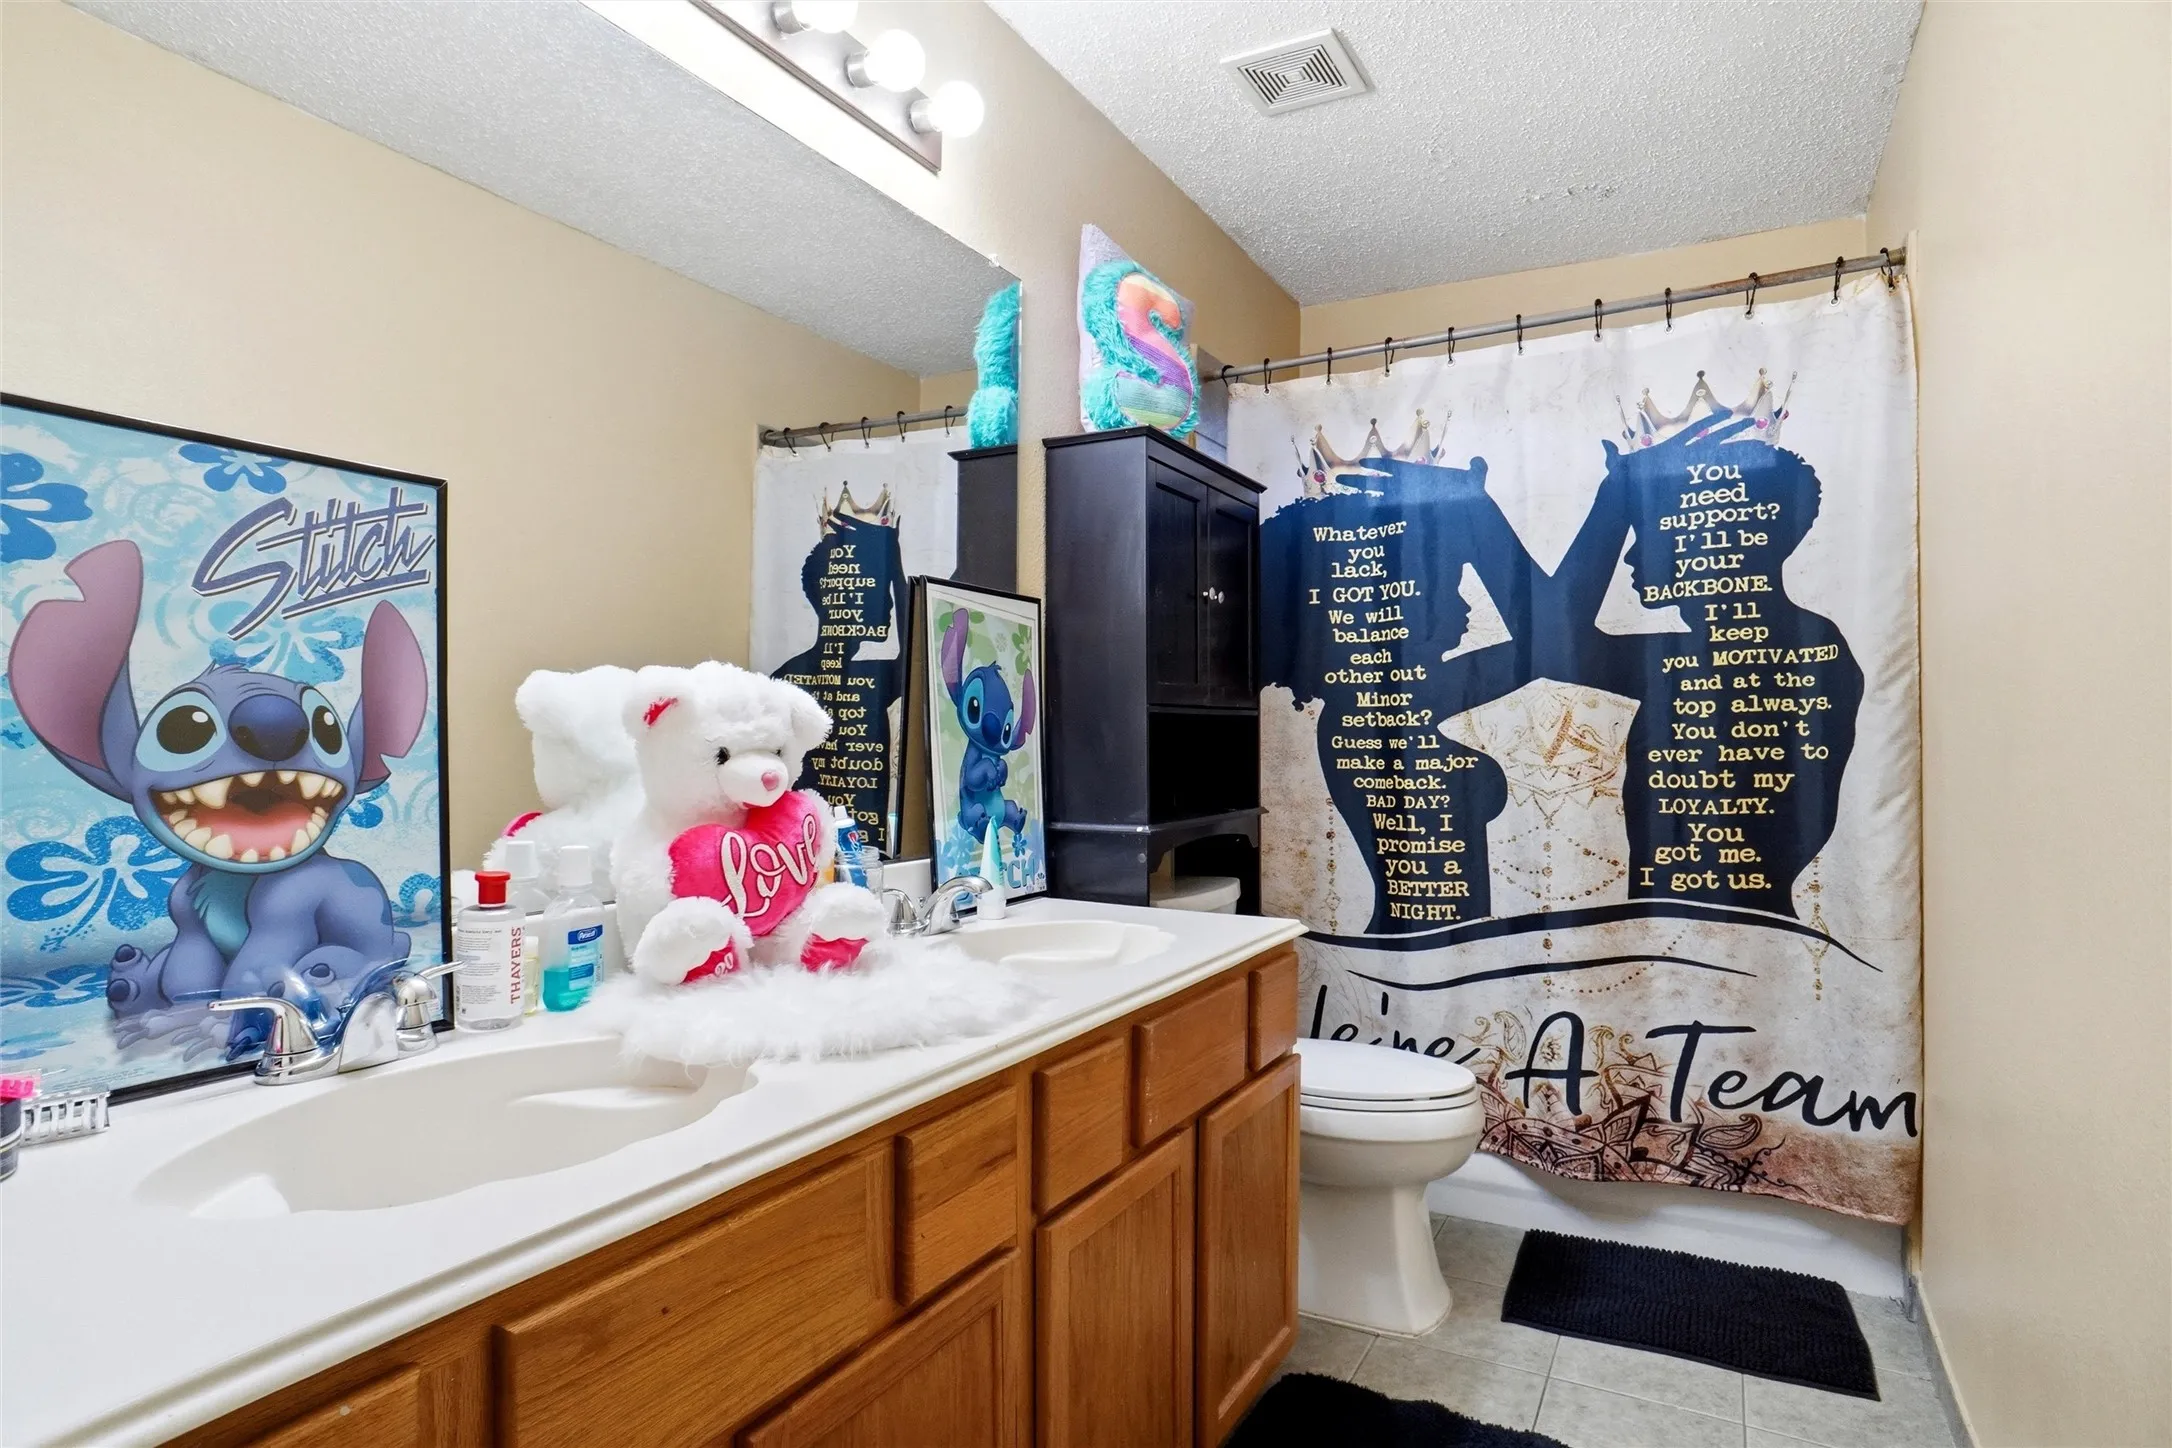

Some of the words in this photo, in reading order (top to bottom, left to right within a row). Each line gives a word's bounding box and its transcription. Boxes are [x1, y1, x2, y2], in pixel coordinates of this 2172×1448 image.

[1685, 463, 1742, 483] You
[1679, 482, 1750, 509] need
[1659, 501, 1781, 531] support?
[1312, 520, 1408, 542] Whatever
[1674, 530, 1732, 553] I'll
[1738, 529, 1768, 546] be
[191, 487, 435, 641] Stitch
[1347, 545, 1386, 565] you
[1331, 560, 1388, 579] lack,
[1675, 553, 1745, 578] your
[1308, 588, 1321, 605] I
[1332, 586, 1375, 603] GOT
[1378, 579, 1421, 601] YOU.
[1643, 574, 1773, 602] BACKBONE.
[1328, 609, 1355, 625] We
[1365, 605, 1404, 624] will
[1704, 601, 1762, 622] I'll
[1332, 627, 1410, 643] balance
[1709, 625, 1769, 643] keep
[1349, 649, 1393, 665] each
[1661, 655, 1700, 674] you
[1712, 643, 1839, 667] MOTIVATED
[1324, 668, 1384, 684] other
[1390, 665, 1427, 682] out
[1680, 674, 1723, 692] and
[1732, 672, 1761, 689] at
[1773, 672, 1816, 688] the
[1356, 691, 1414, 708] Minor
[1672, 697, 1716, 718] top
[1730, 694, 1832, 715] always.
[1341, 709, 1433, 728] setback?
[1671, 722, 1717, 740] You
[1731, 719, 1811, 738] don't
[1331, 735, 1383, 750] Guess
[1388, 734, 1441, 750] we'll
[1647, 749, 1703, 763] ever
[1718, 744, 1785, 762] have
[1800, 743, 1829, 760] to
[1336, 755, 1386, 770] make
[1393, 758, 1405, 770] a
[1415, 755, 1479, 773] major
[1353, 774, 1447, 790] comeback.
[1648, 769, 1736, 789] doubt
[1753, 773, 1796, 793] my
[1365, 794, 1396, 808] BAD
[1403, 794, 1451, 809] DAY?
[1658, 797, 1775, 816] LOYALTY.
[1372, 813, 1427, 835] Well,
[1439, 814, 1454, 832] I
[1687, 823, 1745, 843] You
[1376, 836, 1466, 855] promise
[1654, 843, 1702, 865] got
[1718, 847, 1762, 864] me.
[1385, 858, 1429, 878] you
[1443, 860, 1463, 875] a
[1387, 879, 1470, 898] BETTER
[1639, 867, 1655, 886] I
[1670, 869, 1720, 892] got
[1727, 873, 1772, 890] us.
[1390, 902, 1462, 921] NIGHT.
[510, 927, 522, 1004] THAYERS
[1505, 1010, 1600, 1117] A
[1645, 1020, 1919, 1138] Team
